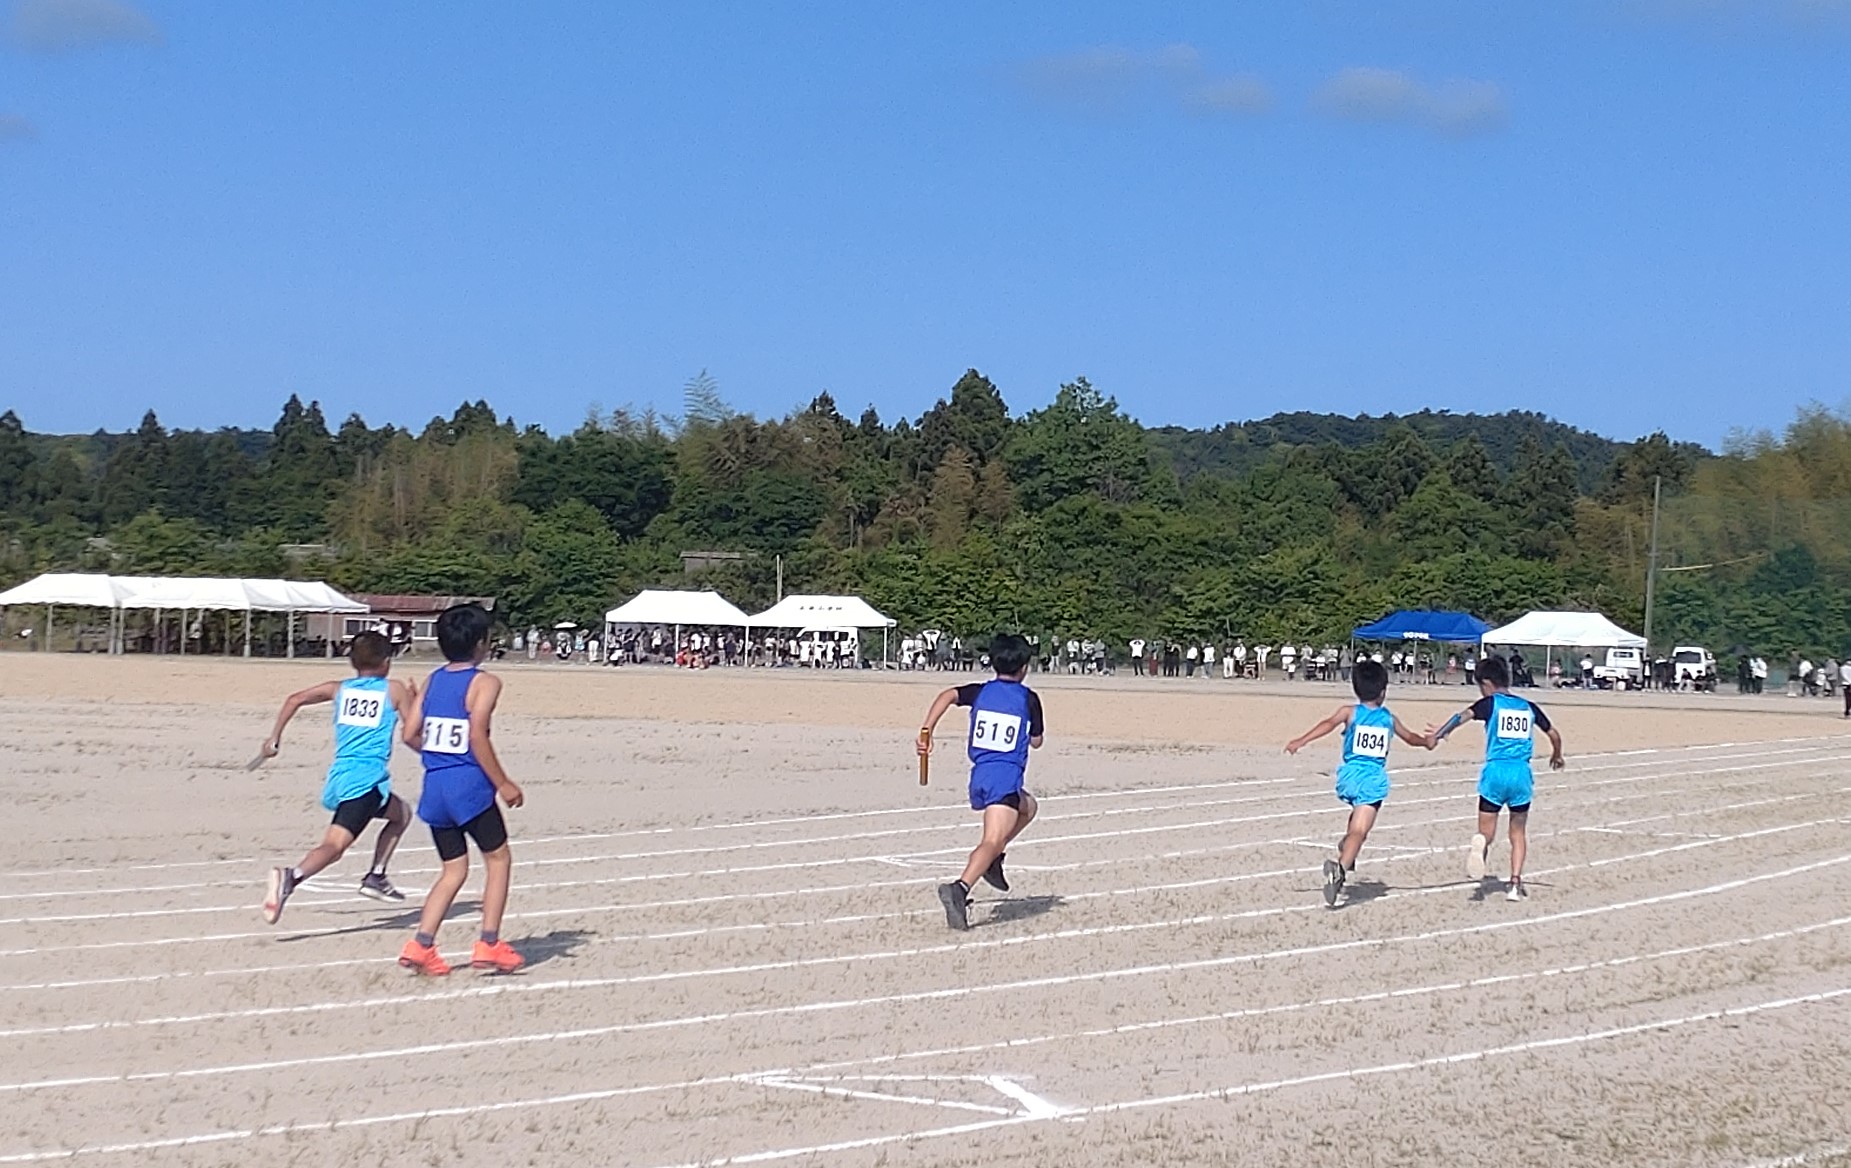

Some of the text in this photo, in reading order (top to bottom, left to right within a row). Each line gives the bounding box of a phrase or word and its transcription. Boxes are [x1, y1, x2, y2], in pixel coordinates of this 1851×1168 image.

[343, 697, 379, 718] 1833
[975, 719, 1016, 745] 519
[1501, 715, 1528, 732] 1830
[1356, 731, 1385, 752] 1834
